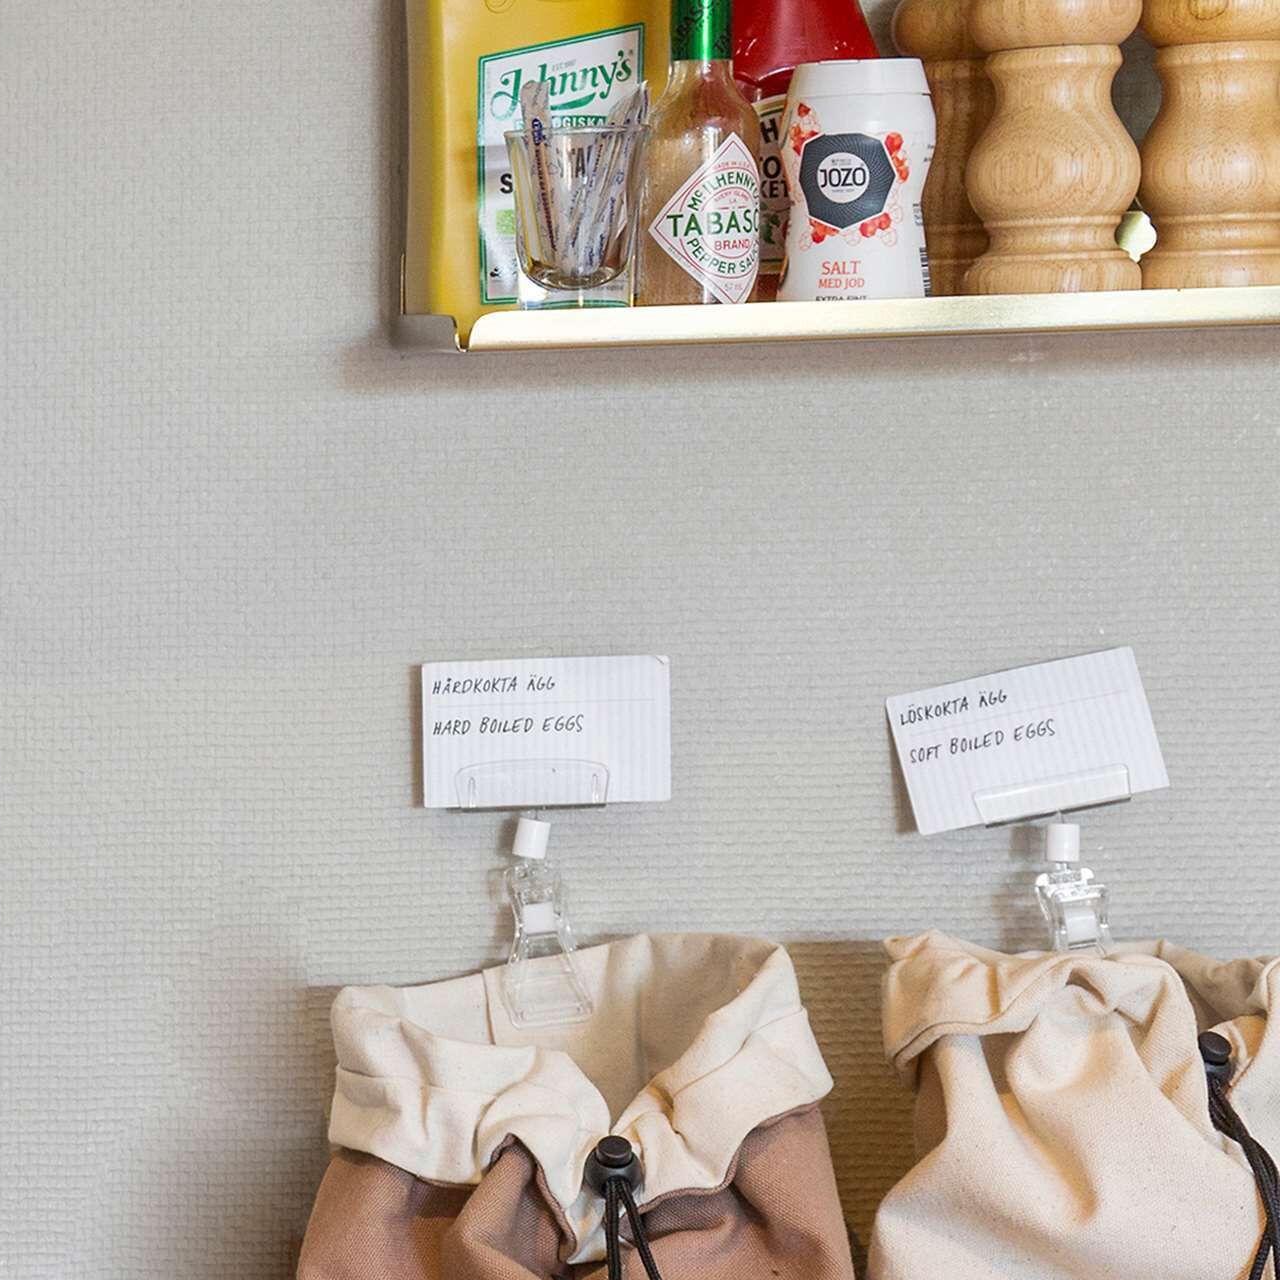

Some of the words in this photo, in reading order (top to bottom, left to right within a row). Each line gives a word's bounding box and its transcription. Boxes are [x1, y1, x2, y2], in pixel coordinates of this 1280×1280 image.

[490, 49, 633, 120] Jhnny's
[820, 167, 866, 188] JOZO
[686, 238, 736, 274] PEPPER
[714, 238, 750, 252] BRAND
[821, 259, 861, 275] SALT
[818, 278, 841, 288] MED
[844, 278, 865, 290] JOD
[432, 676, 518, 696] HÅRDKOKTA
[526, 674, 556, 692] ÄGG
[899, 696, 969, 726] LÖSKOKTA
[978, 689, 1008, 708] ÄGG
[433, 719, 472, 736] HARD
[479, 716, 534, 735] BOILED
[542, 714, 585, 733] EGGS
[910, 743, 942, 764] SOFT
[949, 730, 1005, 756] BOILED
[1013, 718, 1056, 743] EGGS
